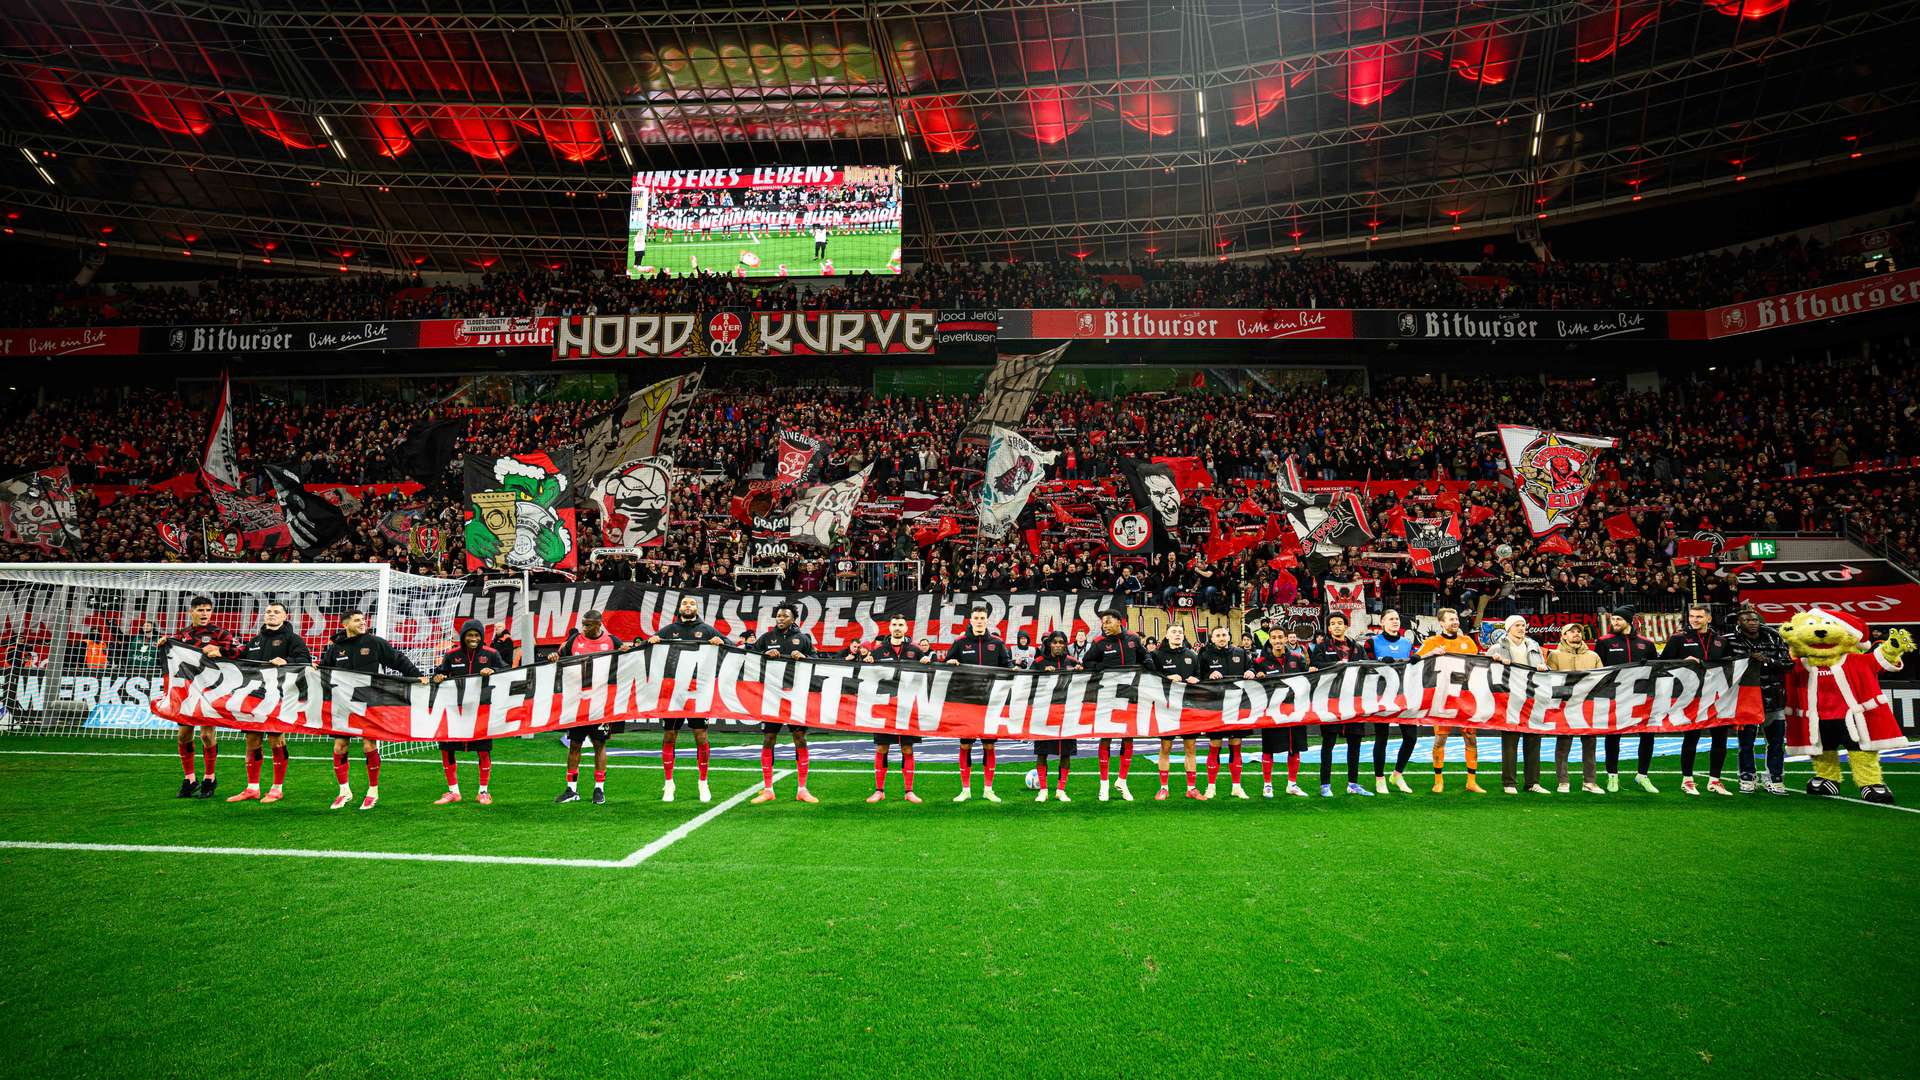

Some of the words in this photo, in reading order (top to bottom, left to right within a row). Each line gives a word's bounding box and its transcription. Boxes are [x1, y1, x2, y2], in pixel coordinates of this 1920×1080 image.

[636, 167, 741, 187] UNSERES
[752, 166, 838, 185] LEBENS
[1757, 280, 1920, 328] Bitburger
[558, 315, 696, 357] NORD
[760, 312, 935, 354] KURVE
[938, 332, 996, 344] Leverkusen
[1104, 311, 1218, 338] Bitburger
[1425, 311, 1539, 338] Bitburger
[191, 327, 293, 351] Bitburger
[710, 340, 738, 357] 04
[1415, 545, 1461, 566] LEVERKUSEN
[640, 589, 886, 648] UNSERES
[915, 592, 1114, 647] LEBENS
[157, 642, 372, 735] FROHE
[410, 644, 953, 739] WEIHNACHTEN
[984, 671, 1190, 737] ALLEN
[1222, 655, 1751, 731] DOUBLESIEGERN
